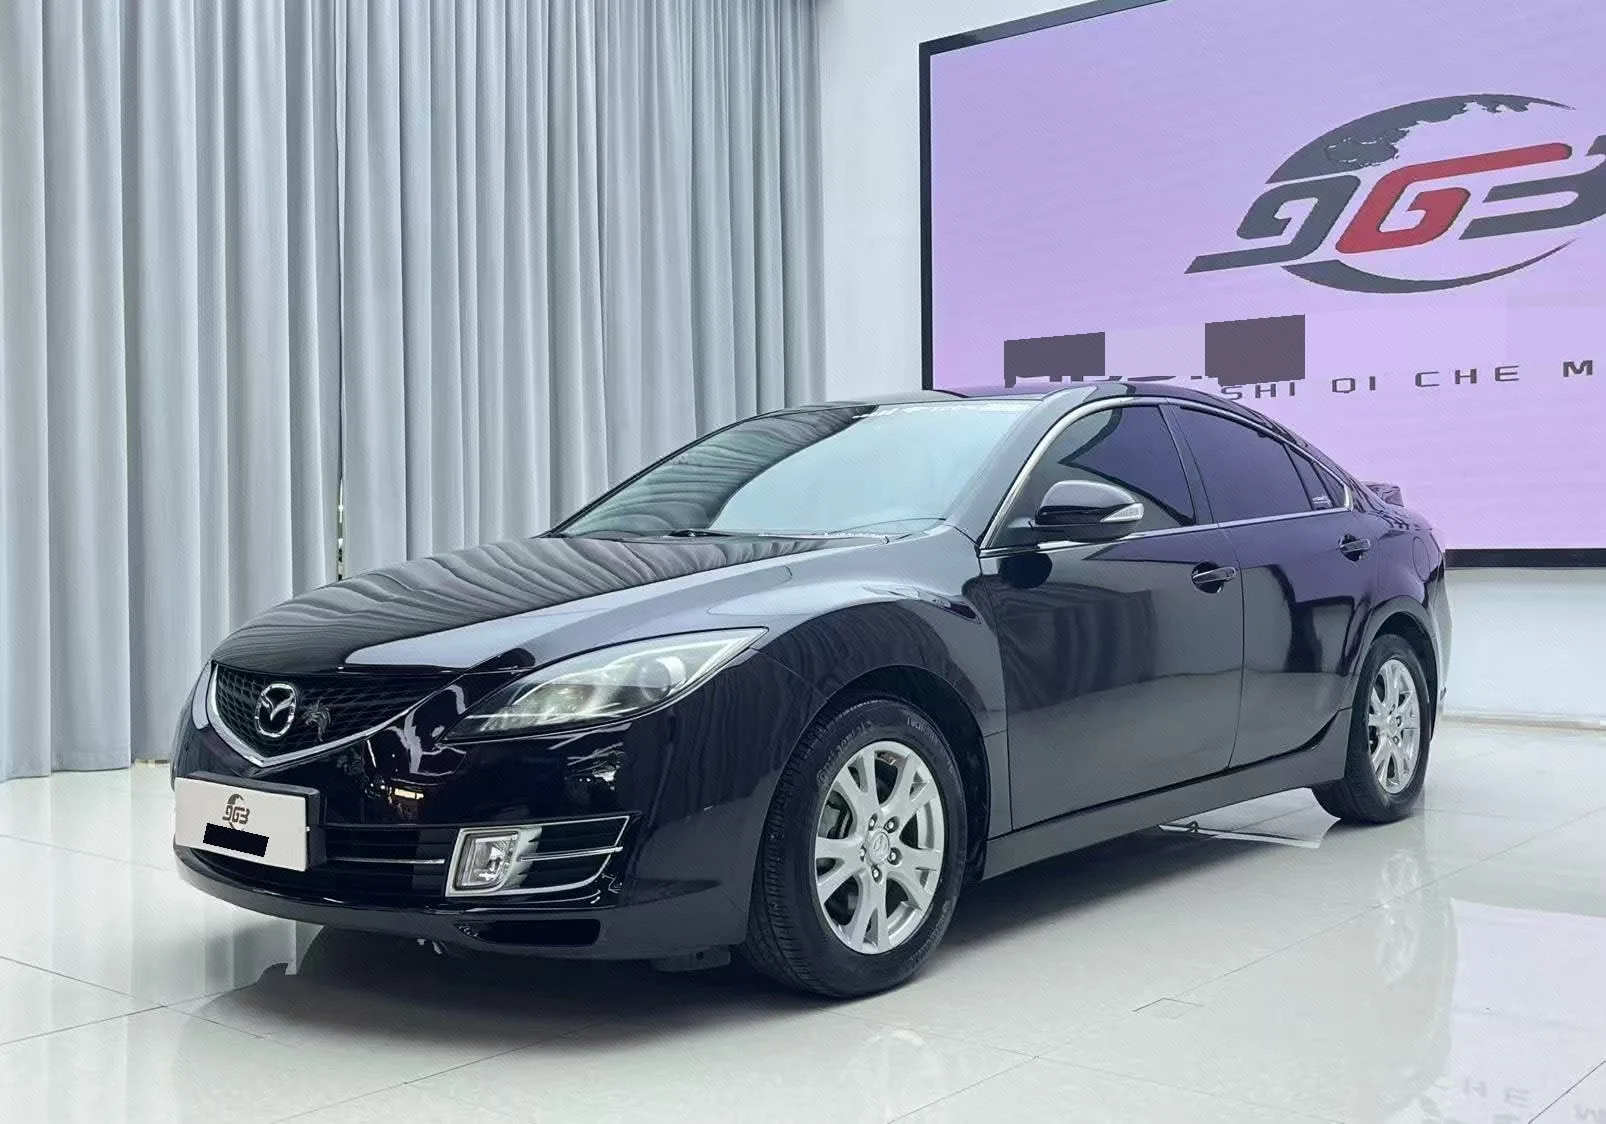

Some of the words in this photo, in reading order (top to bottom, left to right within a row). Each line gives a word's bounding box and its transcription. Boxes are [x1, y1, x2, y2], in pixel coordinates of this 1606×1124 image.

[1220, 382, 1295, 400] SHI
[1415, 365, 1520, 387] CHE
[1563, 360, 1593, 377] M
